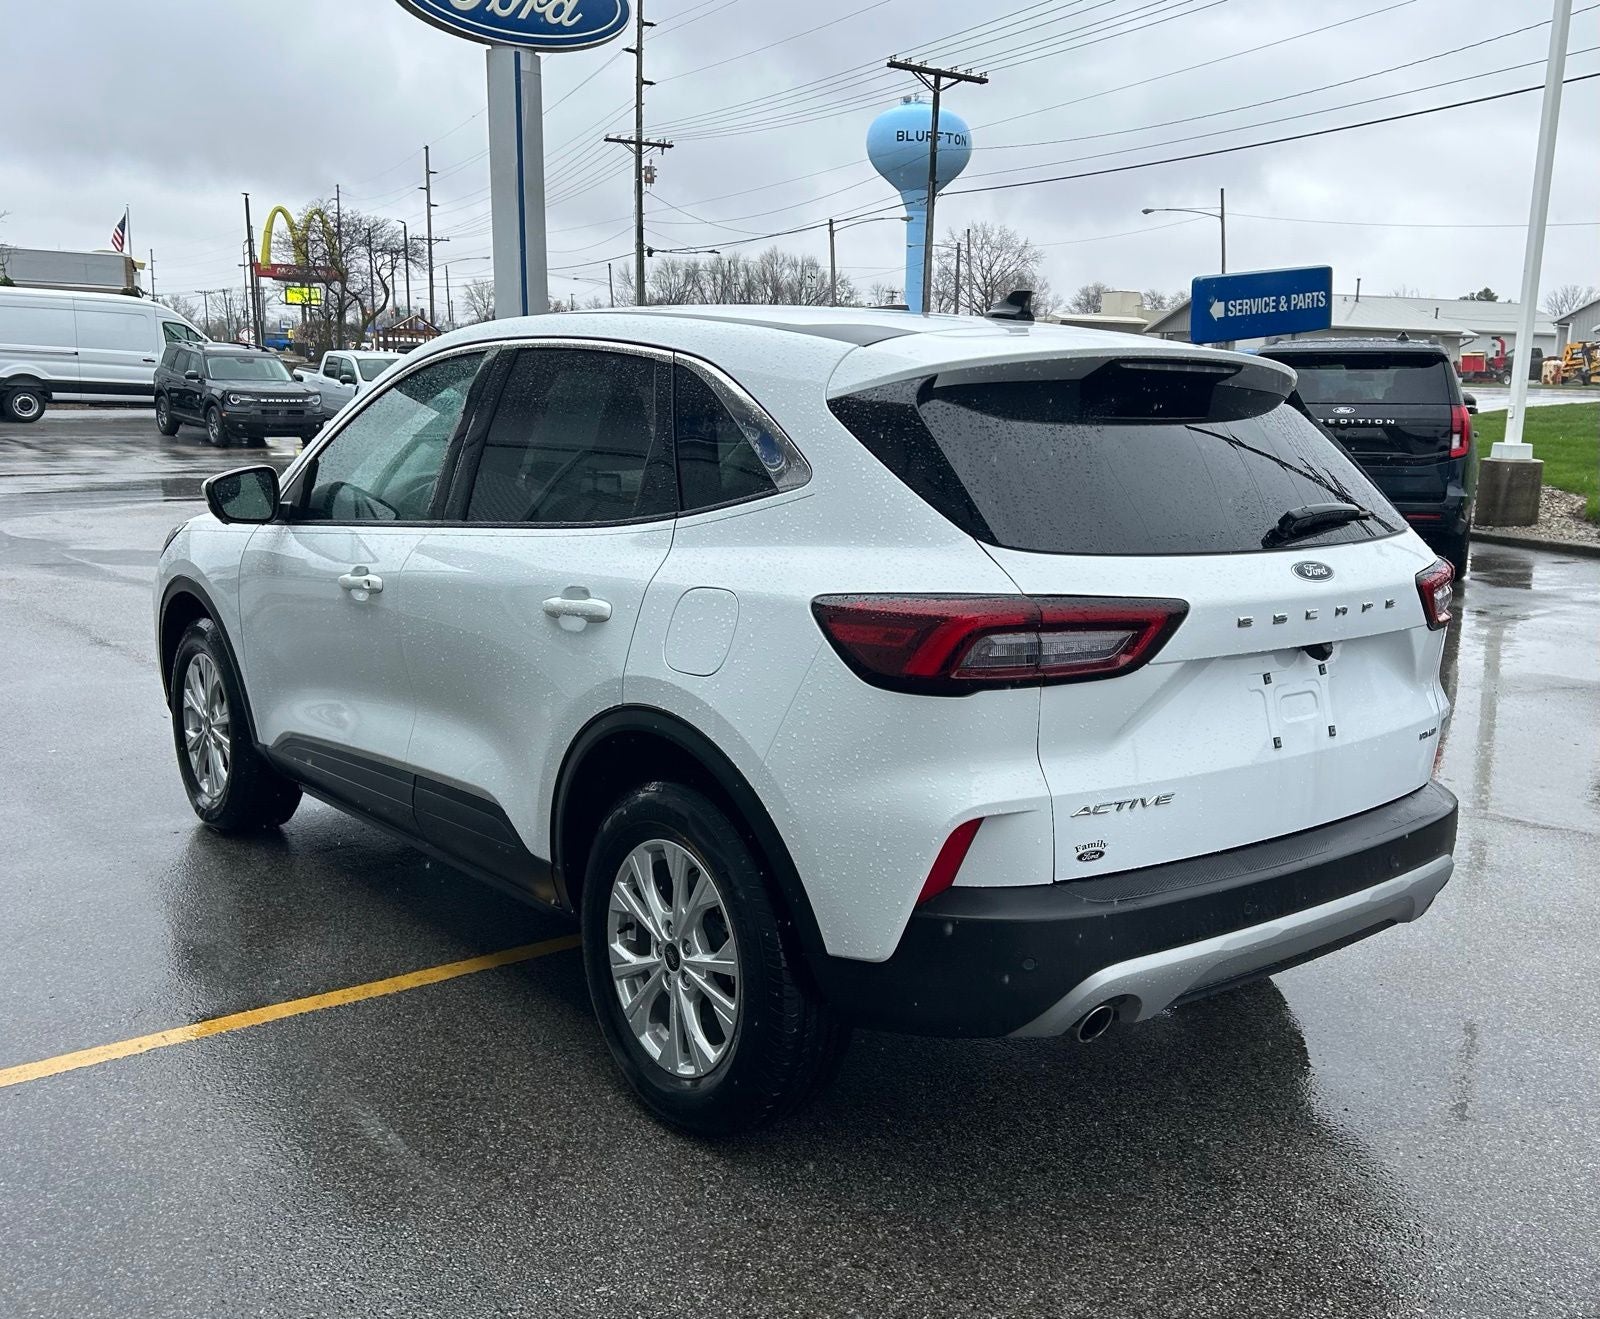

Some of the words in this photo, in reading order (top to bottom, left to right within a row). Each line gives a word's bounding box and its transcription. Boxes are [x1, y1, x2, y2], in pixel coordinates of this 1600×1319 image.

[450, 0, 583, 27] ord
[1227, 296, 1277, 317] SERVICE
[1279, 294, 1288, 312] &
[1290, 291, 1326, 311] PARTS
[1237, 598, 1396, 628] ESCAPE
[1069, 792, 1176, 818] ACTIVE
[1074, 839, 1109, 854] Family
